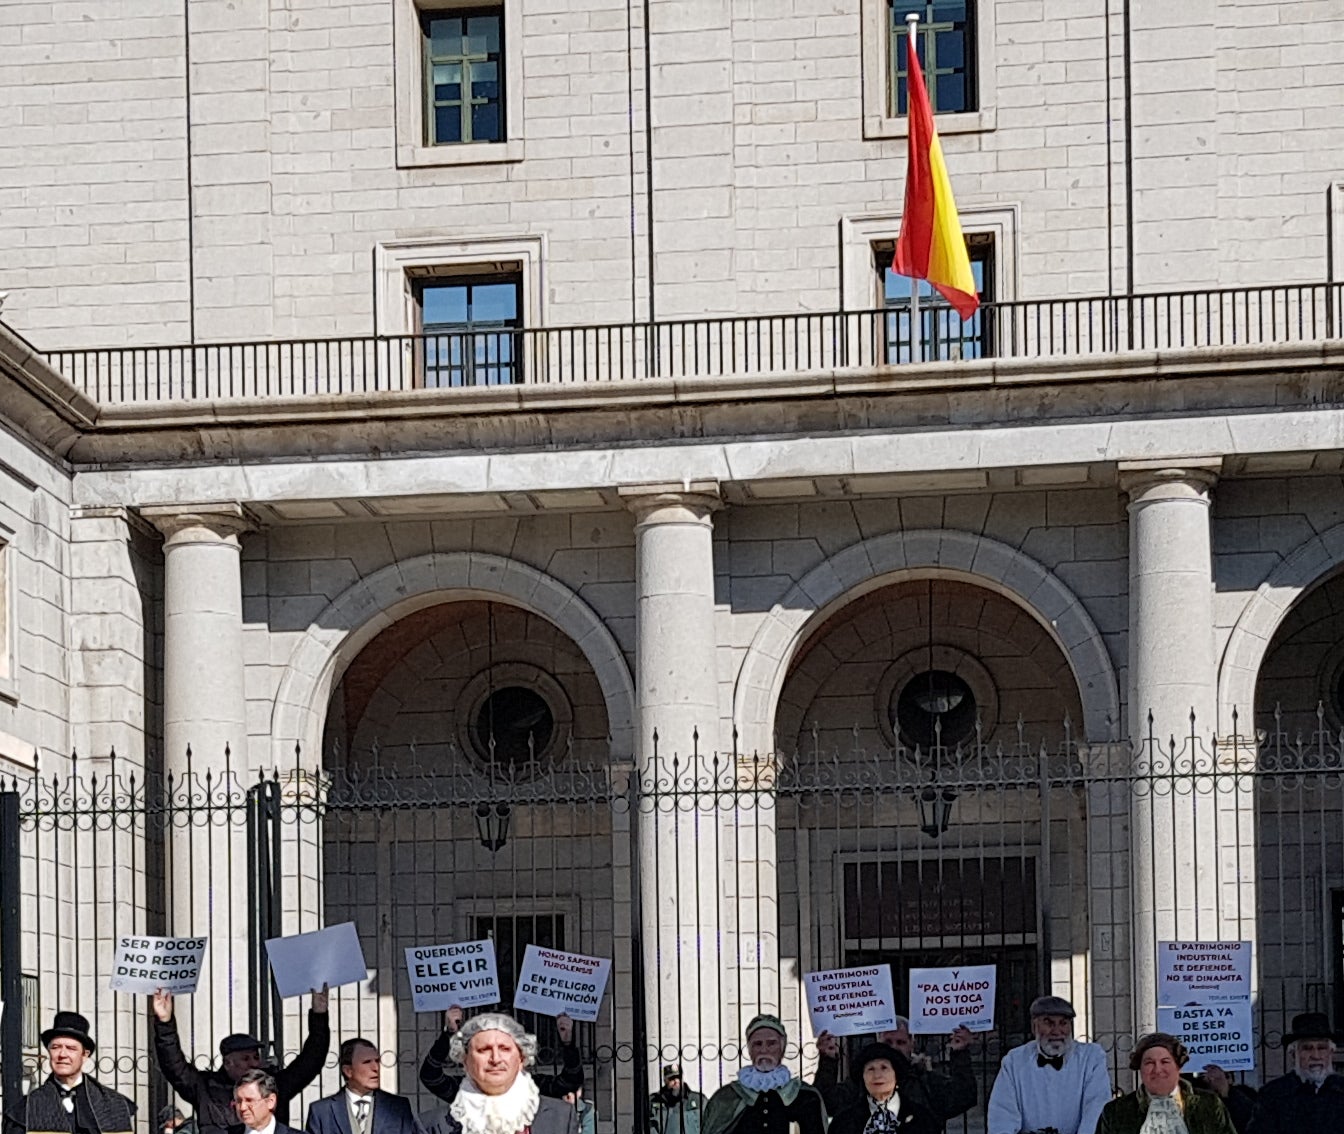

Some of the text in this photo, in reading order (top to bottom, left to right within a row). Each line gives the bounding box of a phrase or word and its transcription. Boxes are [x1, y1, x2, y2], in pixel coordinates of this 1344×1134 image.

[120, 938, 205, 951] SER POCOS
[1168, 943, 1241, 951] EL PATRIMONIO
[414, 943, 483, 960] QUEREMOS
[123, 953, 196, 966] NO RESTA
[538, 950, 601, 967] HOMO SAPIENS
[117, 966, 198, 981] DERECHOS
[415, 958, 488, 978] ELEGIR
[543, 960, 593, 975] TUROLENSIS
[1172, 964, 1184, 972] SE
[811, 968, 879, 983] EL PATRIMONIO
[952, 970, 960, 980] Y
[1166, 974, 1243, 982] NO SE DINAMITA
[415, 977, 494, 993] DONDE VIVIR
[531, 973, 596, 993] EN PELIGRO
[819, 980, 872, 992] INDUSTRIAL
[943, 980, 990, 993] CUÁNDO
[522, 984, 598, 1005] DE EXTINCIÓN
[817, 994, 827, 1003] SE
[925, 993, 983, 1005] NOS TOCA
[813, 999, 885, 1014] NO SE DINAMITA
[922, 1007, 938, 1017] LO
[1173, 1007, 1233, 1019] BASTA YA
[1182, 1020, 1226, 1031] DE SER
[1175, 1031, 1241, 1043] ERRITORIO
[1188, 1043, 1249, 1055] ACRIFICIO
